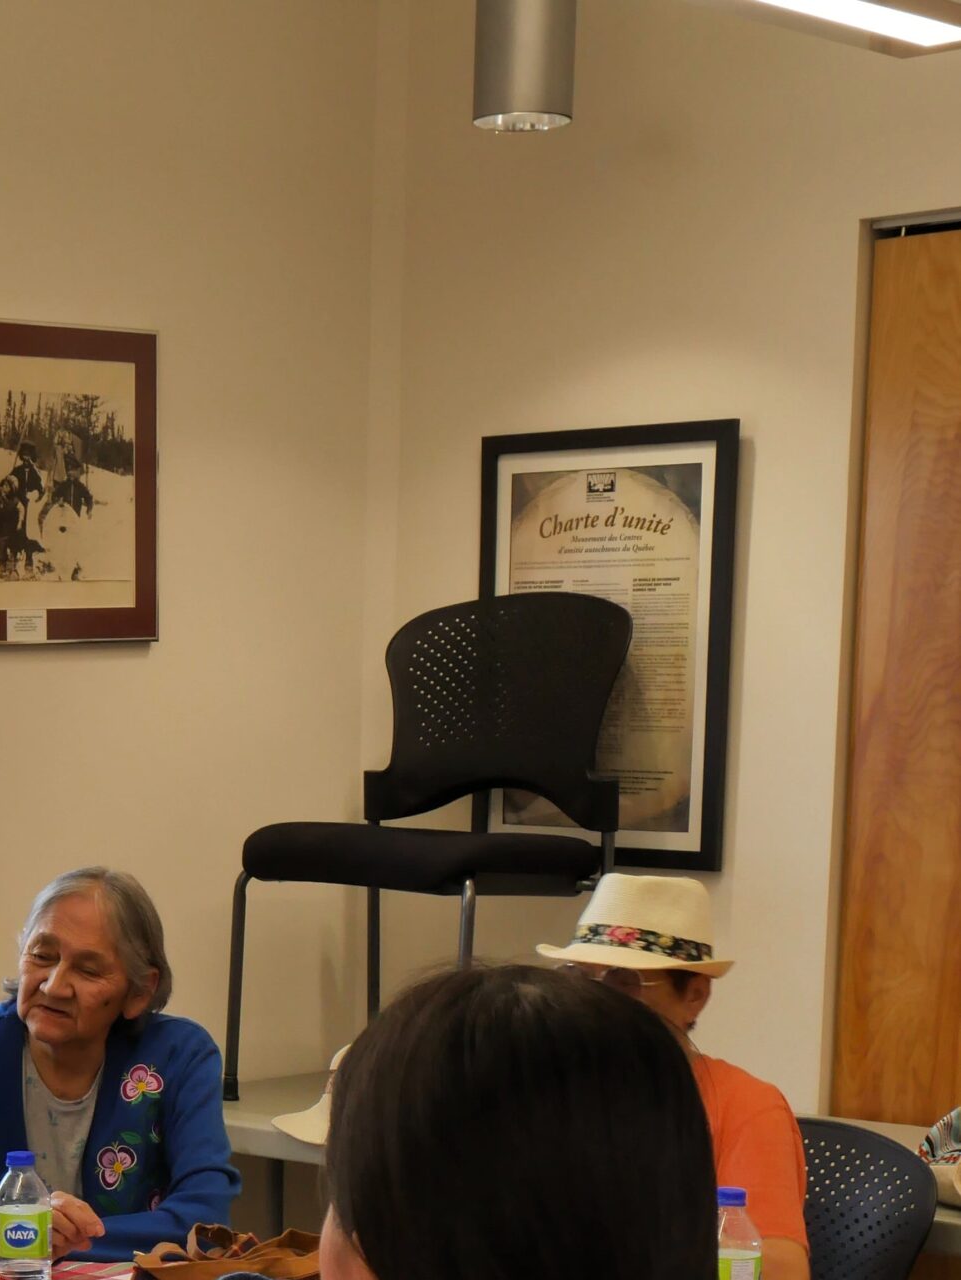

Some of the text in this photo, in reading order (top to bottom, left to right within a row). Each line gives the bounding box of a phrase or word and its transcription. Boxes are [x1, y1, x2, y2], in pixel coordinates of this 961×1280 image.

[539, 506, 674, 539] Charte d'unité
[607, 533, 618, 541] des
[622, 544, 631, 552] du
[6, 1229, 36, 1240] NAYA
